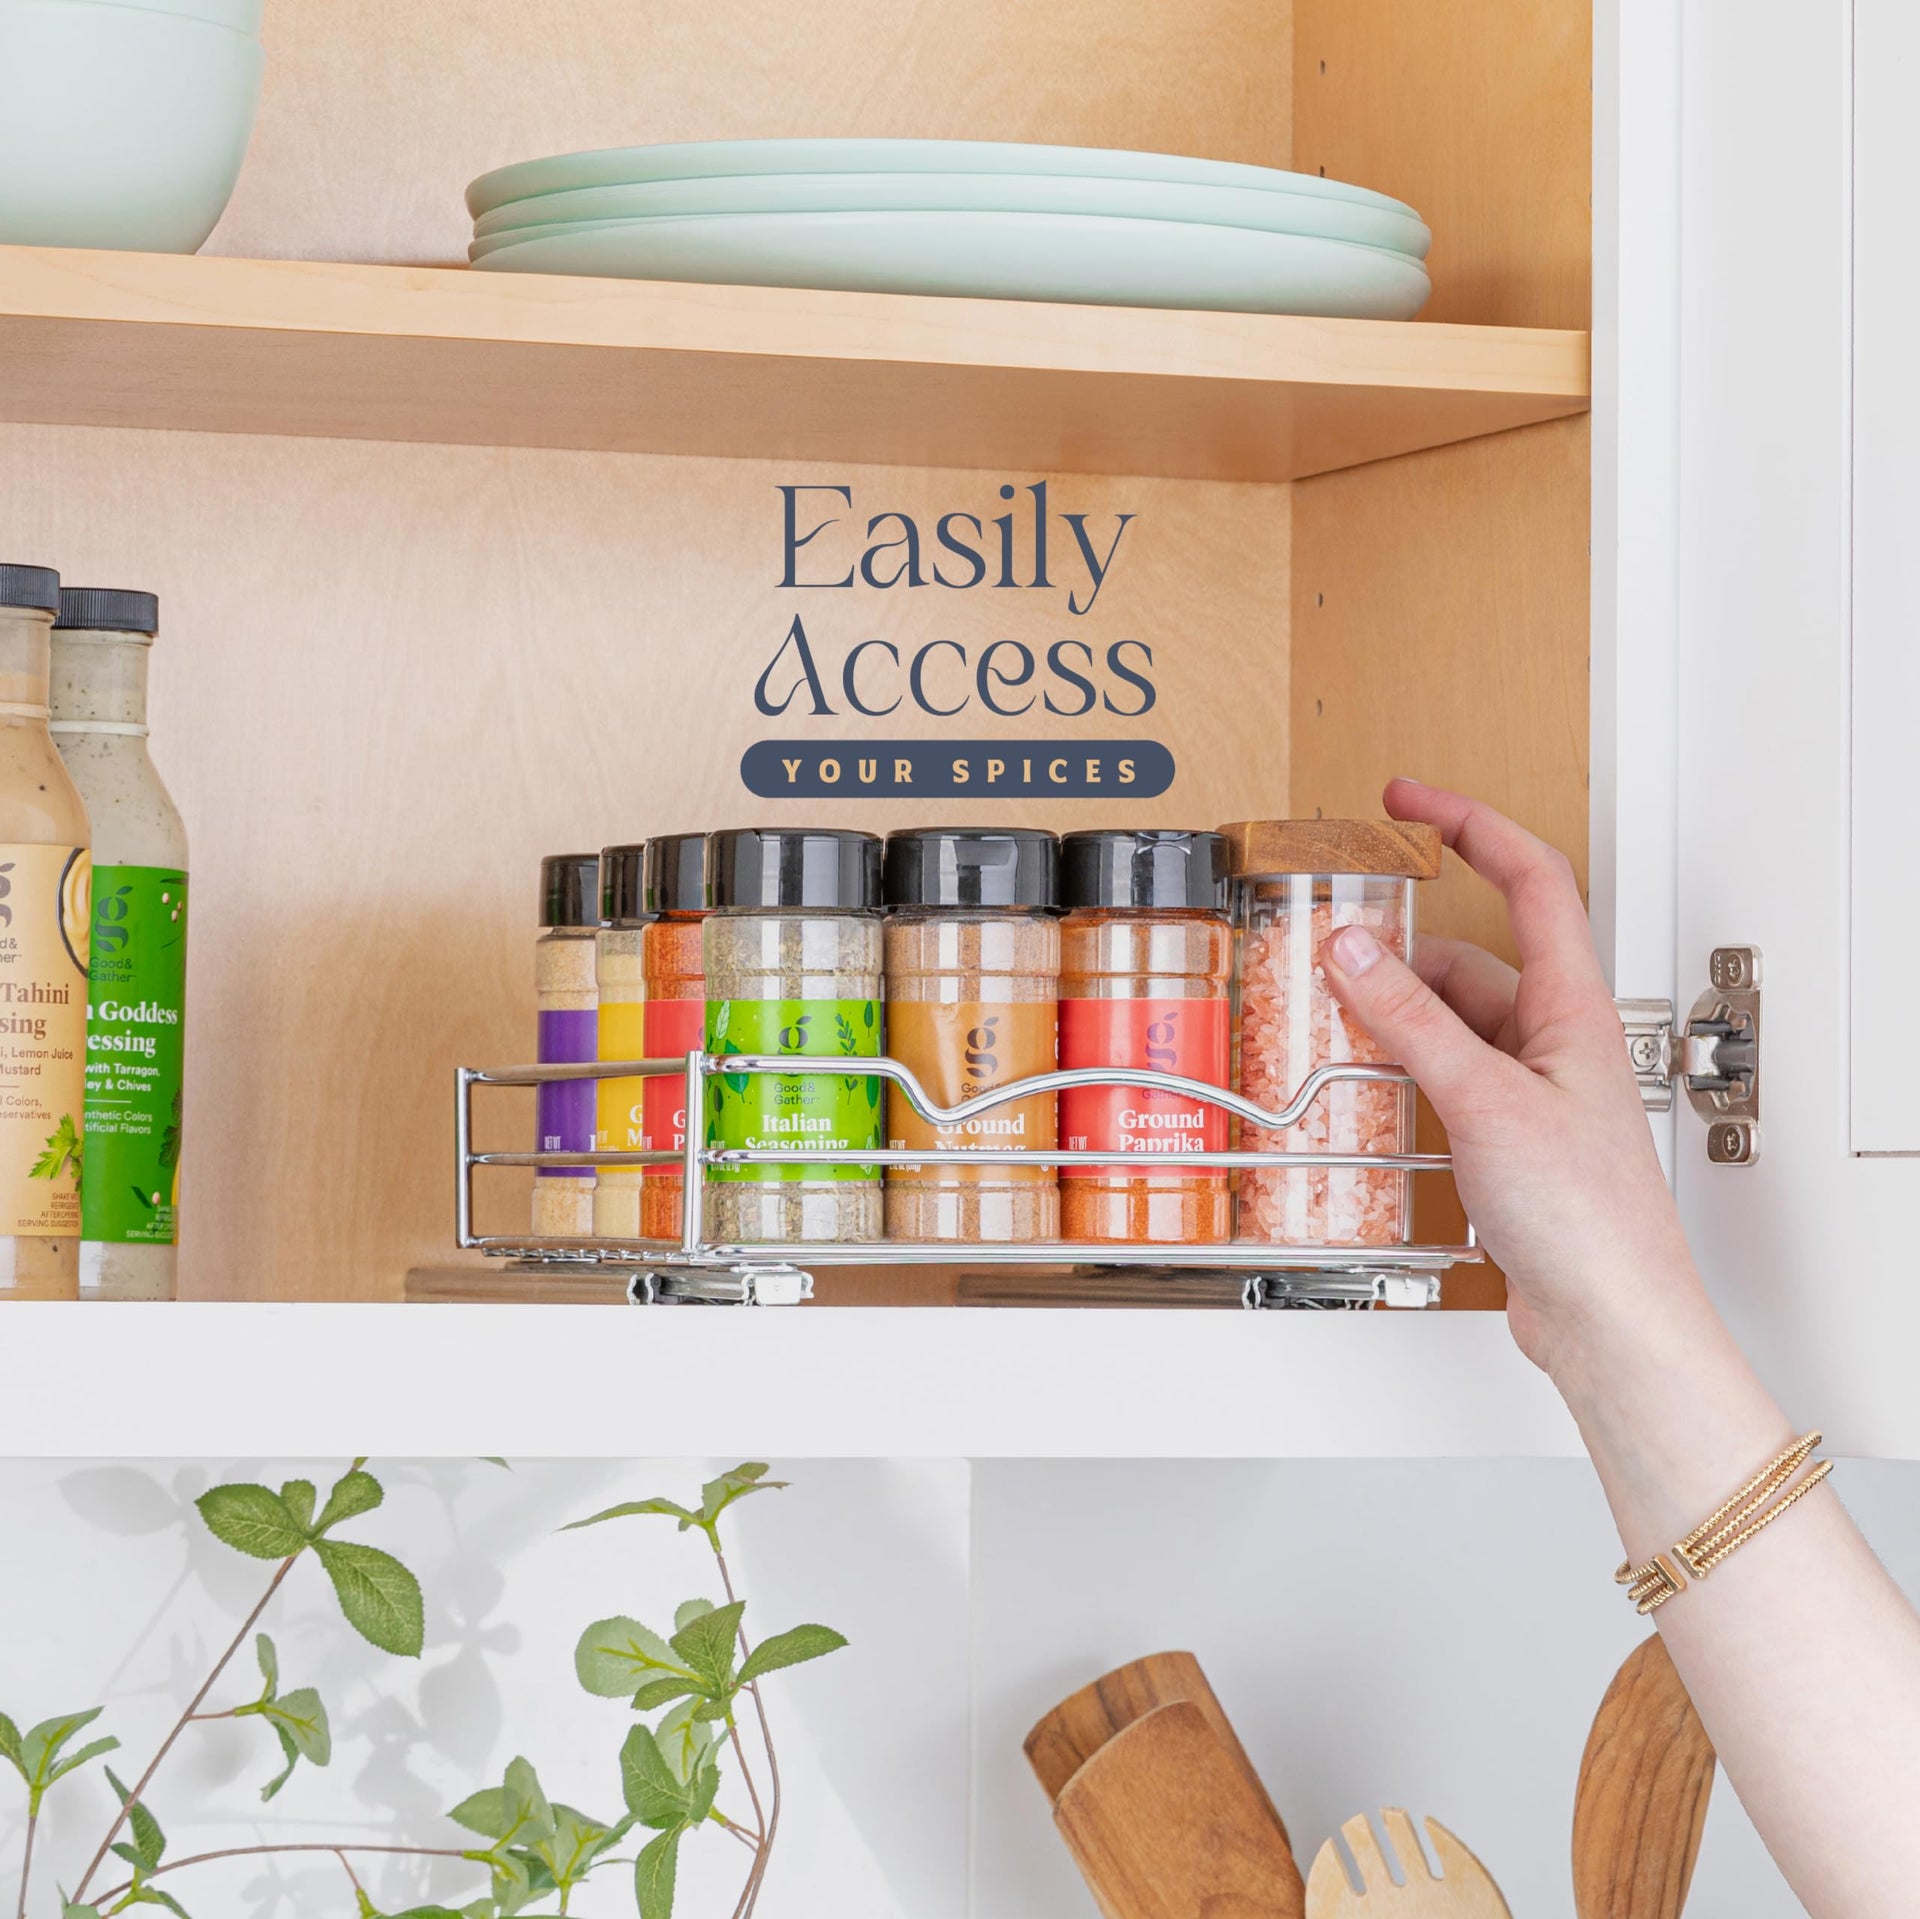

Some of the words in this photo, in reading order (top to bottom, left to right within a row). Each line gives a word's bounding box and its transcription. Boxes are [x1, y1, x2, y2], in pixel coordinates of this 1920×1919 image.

[1, 981, 70, 1005] Tahini
[99, 1000, 178, 1025] Goddess
[11, 1047, 49, 1059] Lemon
[51, 1047, 73, 1060] Juice
[104, 1079, 114, 1091] &
[116, 1079, 152, 1092] Chives
[0, 1109, 52, 1120] servatives
[123, 1110, 153, 1122] Colors
[1118, 1108, 1205, 1129] Ground
[120, 1122, 152, 1135] Flavors
[762, 1113, 832, 1133] Italian
[1118, 1132, 1205, 1152] Paprika
[17, 1219, 49, 1228] SERVING
